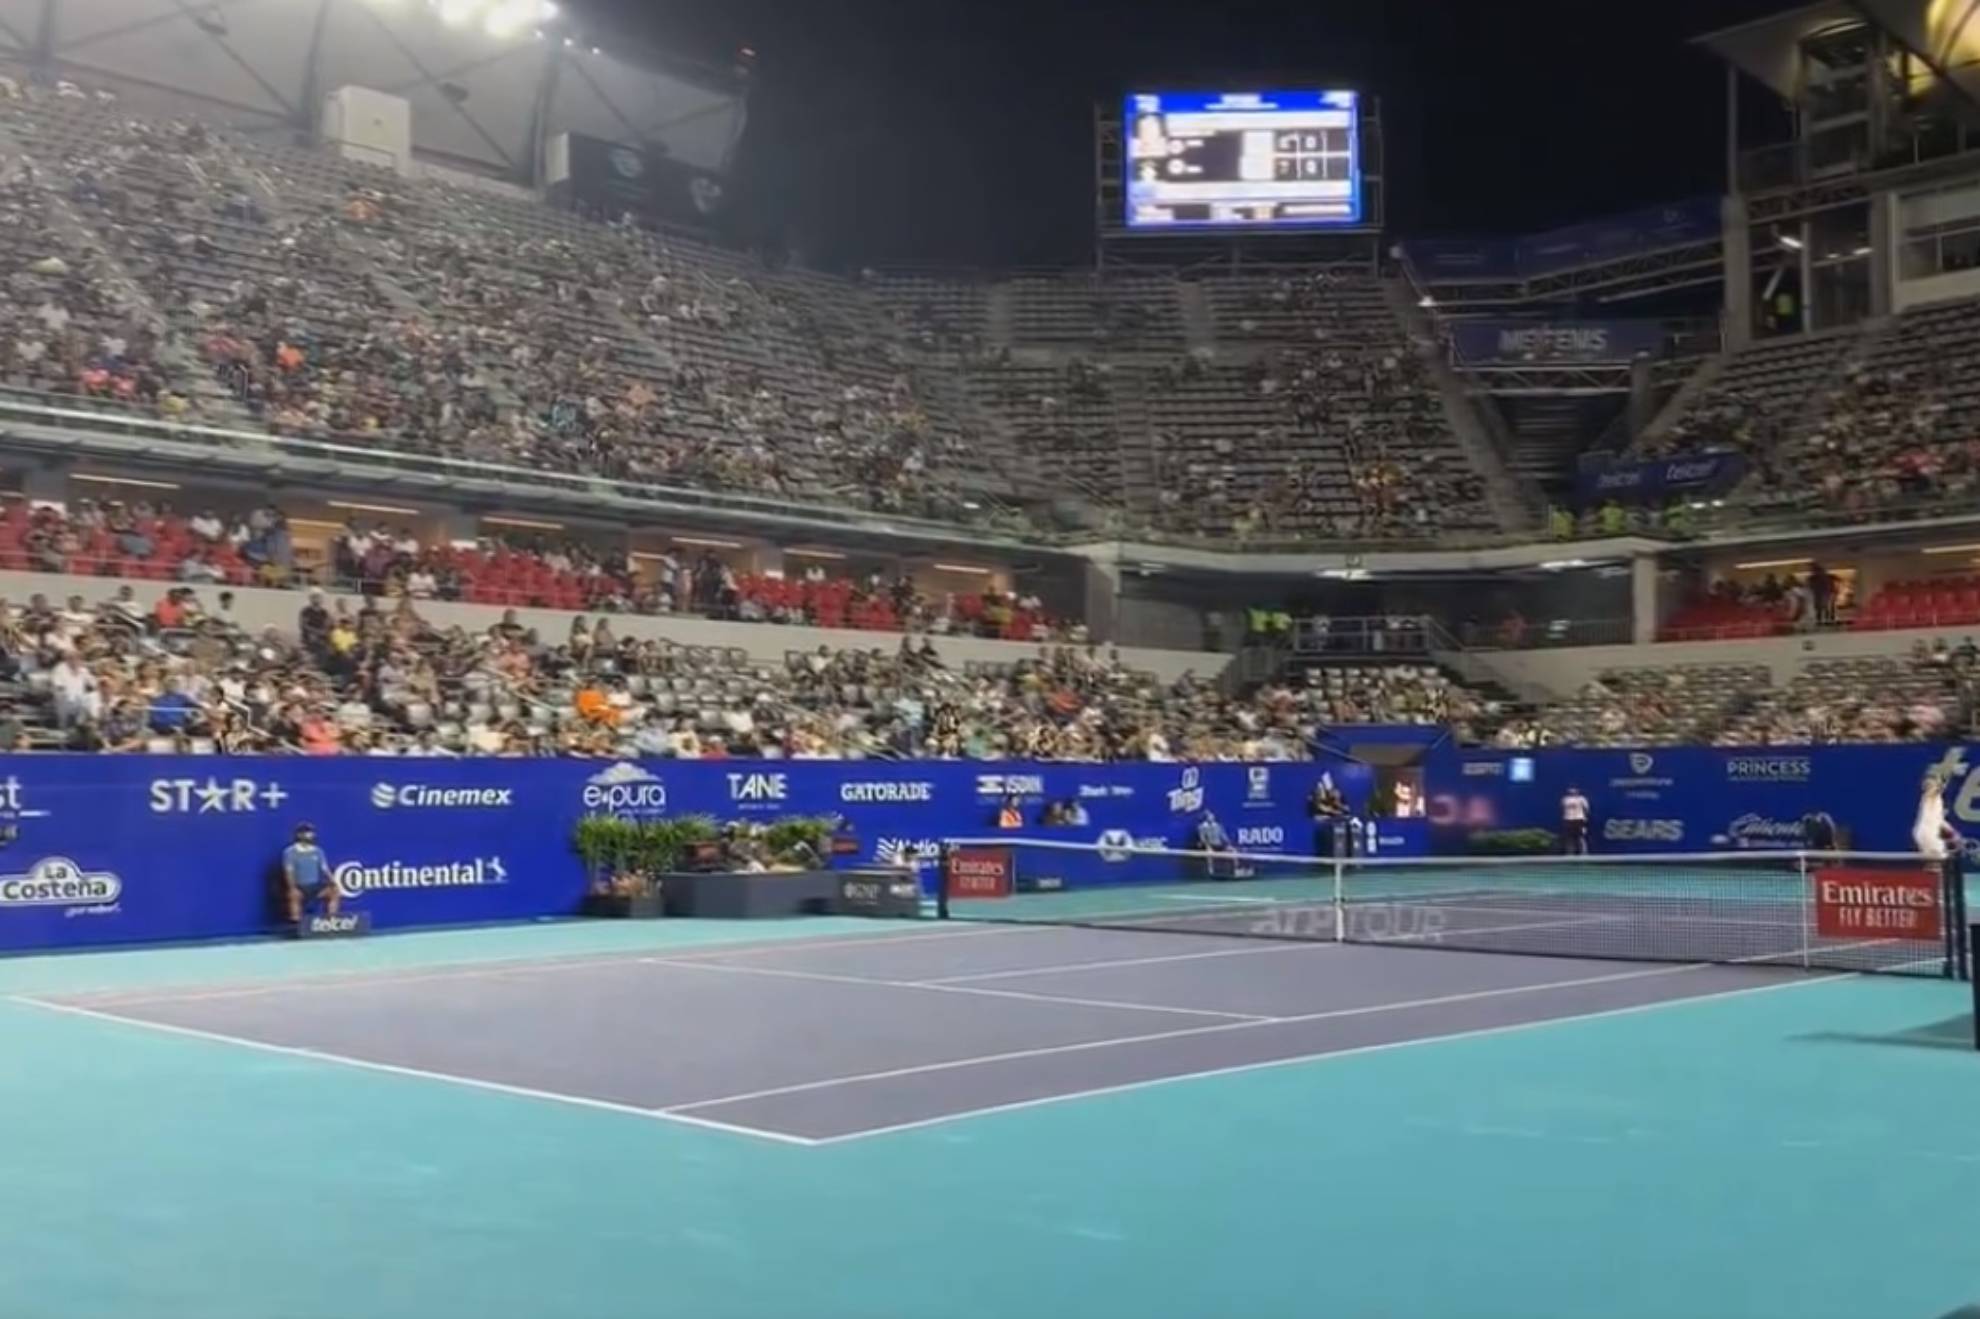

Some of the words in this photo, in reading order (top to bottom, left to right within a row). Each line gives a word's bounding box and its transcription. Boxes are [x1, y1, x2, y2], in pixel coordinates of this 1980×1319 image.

[1726, 759, 1811, 776] PRINCESS
[399, 784, 512, 807] Cinemex
[727, 773, 787, 799] TANE
[840, 782, 933, 801] GATORADE
[1238, 827, 1284, 844] RADO
[1603, 819, 1684, 841] SEARS
[44, 866, 68, 880] La
[335, 858, 484, 898] Continental
[1822, 880, 1933, 907] Emirates
